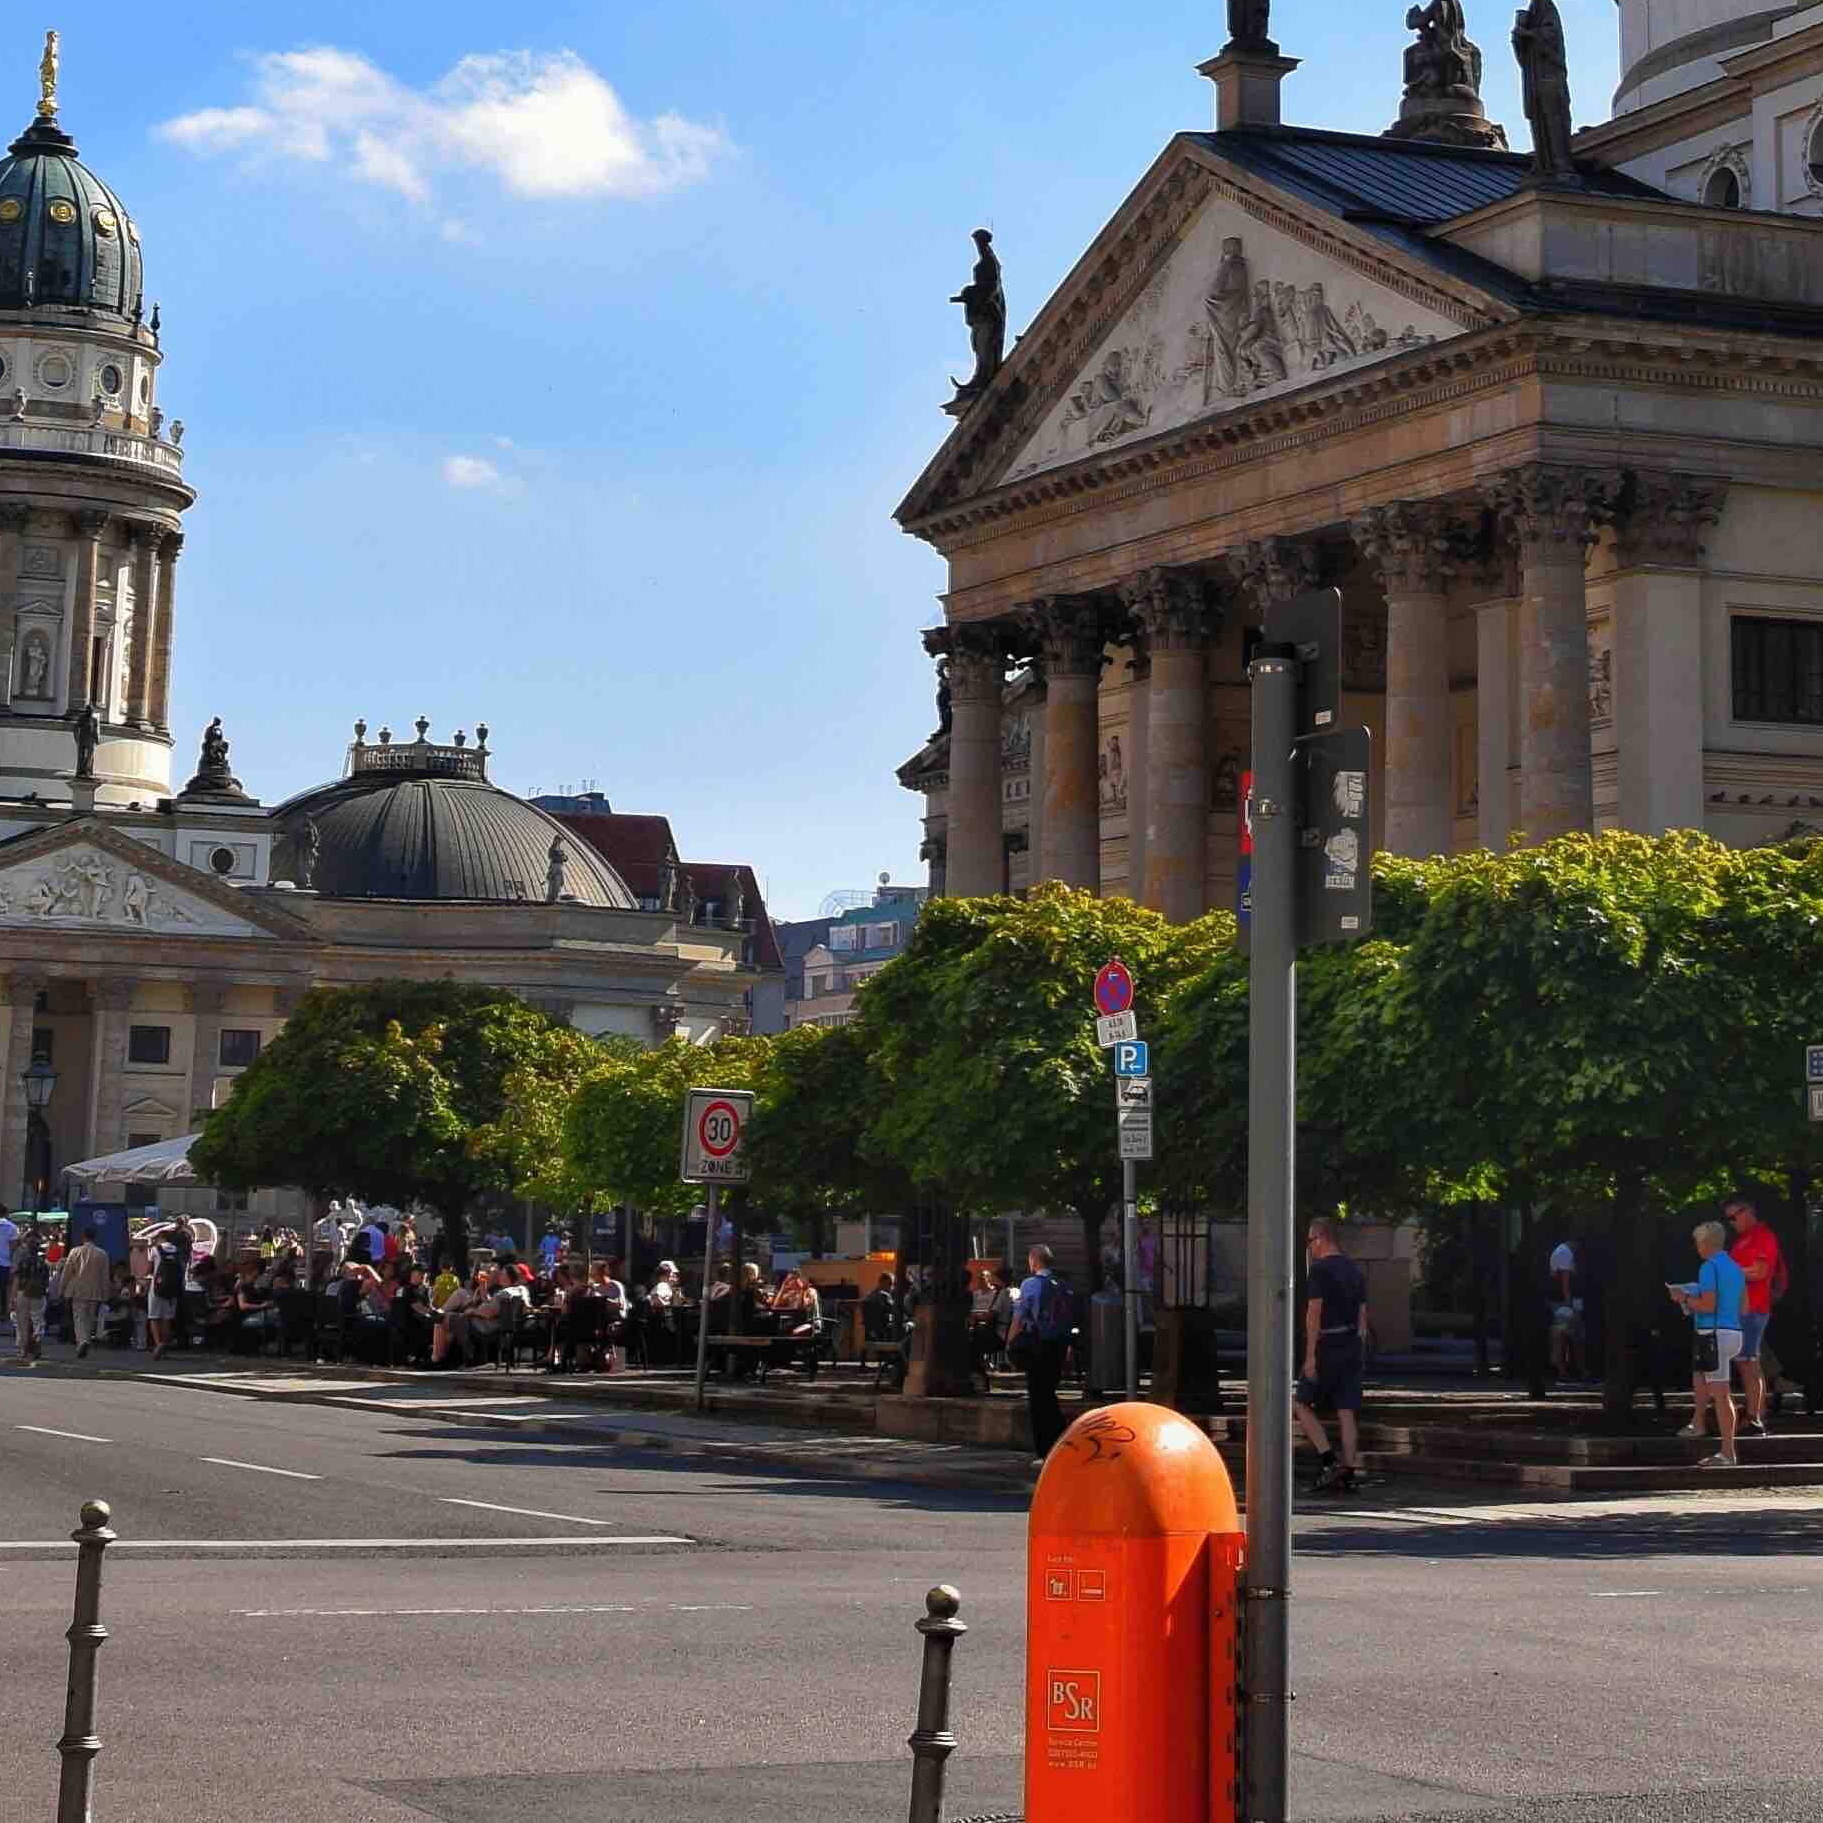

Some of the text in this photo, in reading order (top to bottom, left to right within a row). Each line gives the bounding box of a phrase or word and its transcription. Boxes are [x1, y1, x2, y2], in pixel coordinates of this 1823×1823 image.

[1121, 1046, 1137, 1070] P
[707, 1117, 731, 1141] 30
[701, 1160, 732, 1174] ZONE
[1053, 1682, 1094, 1720] BSR
